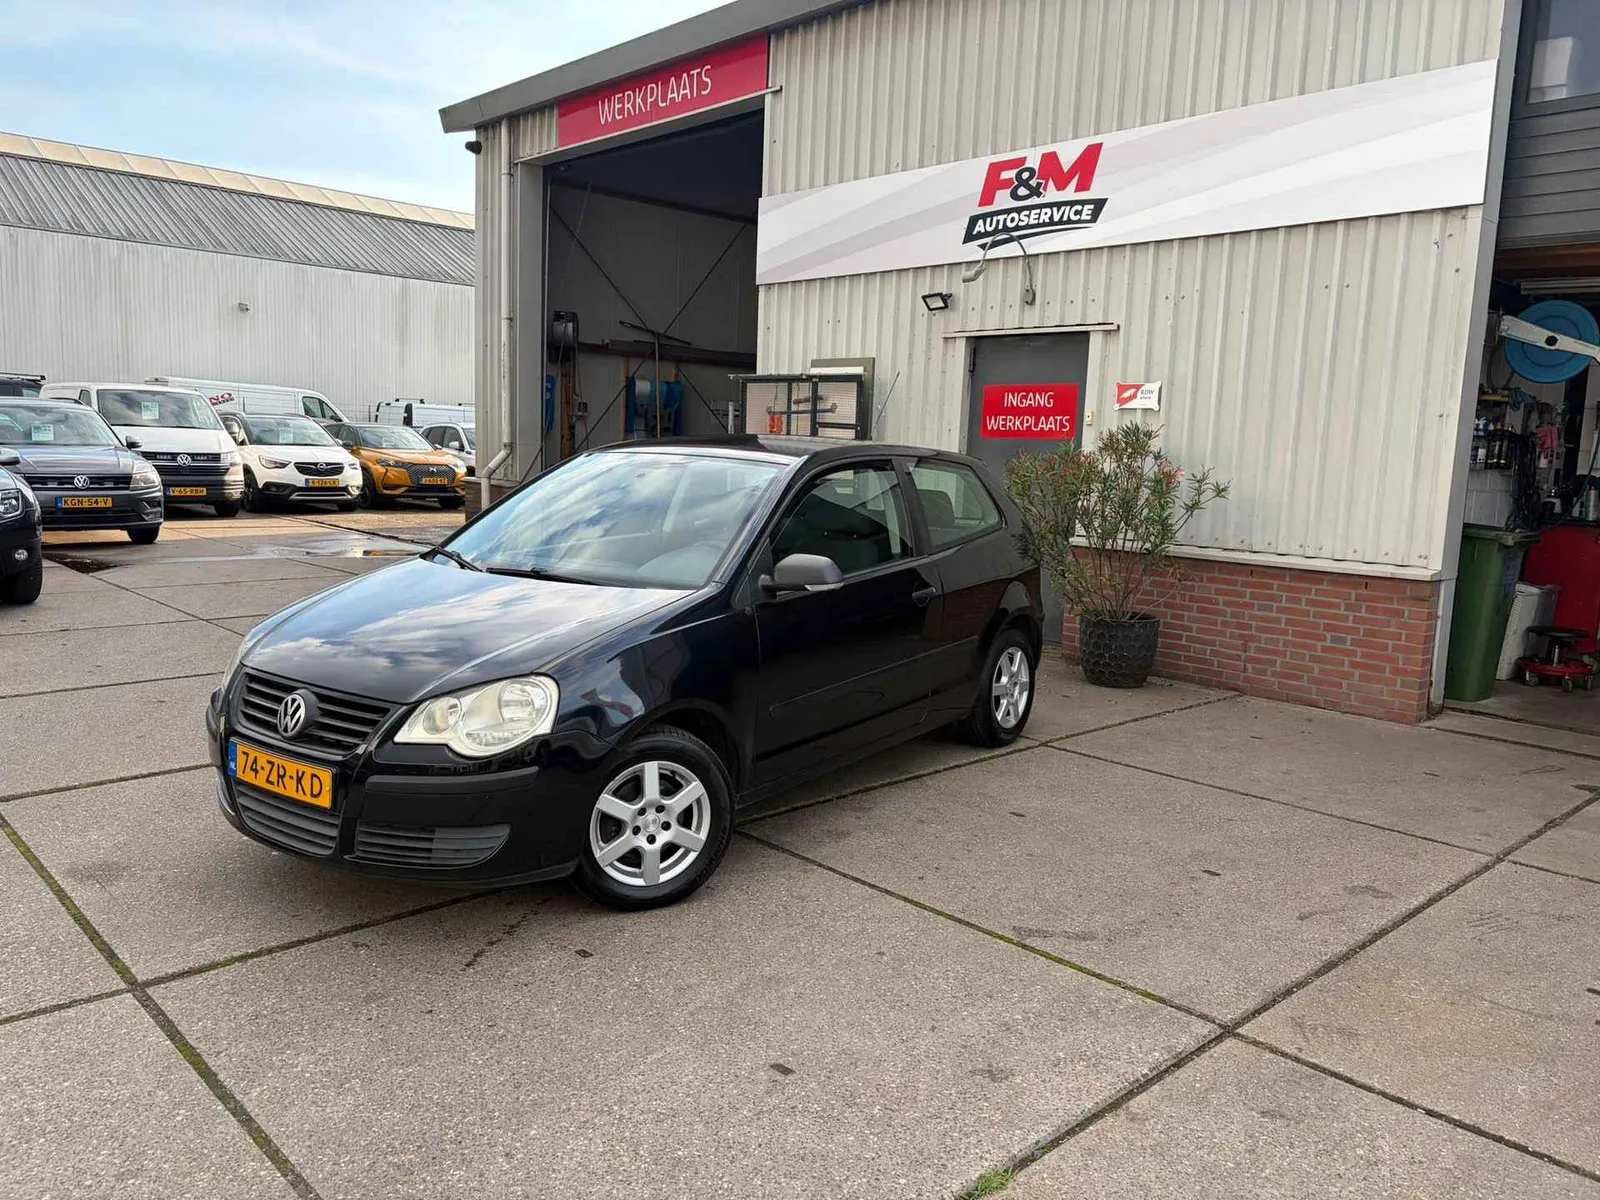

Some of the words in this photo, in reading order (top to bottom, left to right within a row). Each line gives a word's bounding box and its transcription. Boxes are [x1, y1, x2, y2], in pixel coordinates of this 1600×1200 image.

[598, 65, 712, 125] WERKPLAATS
[978, 142, 1104, 207] F&M
[972, 204, 1094, 235] AUTOSERVICE
[1004, 391, 1054, 408] INGANG
[986, 415, 1070, 432] WERKPLAATS
[63, 497, 108, 507] KGN-54-V
[240, 751, 323, 799] 74-ZR-KD
